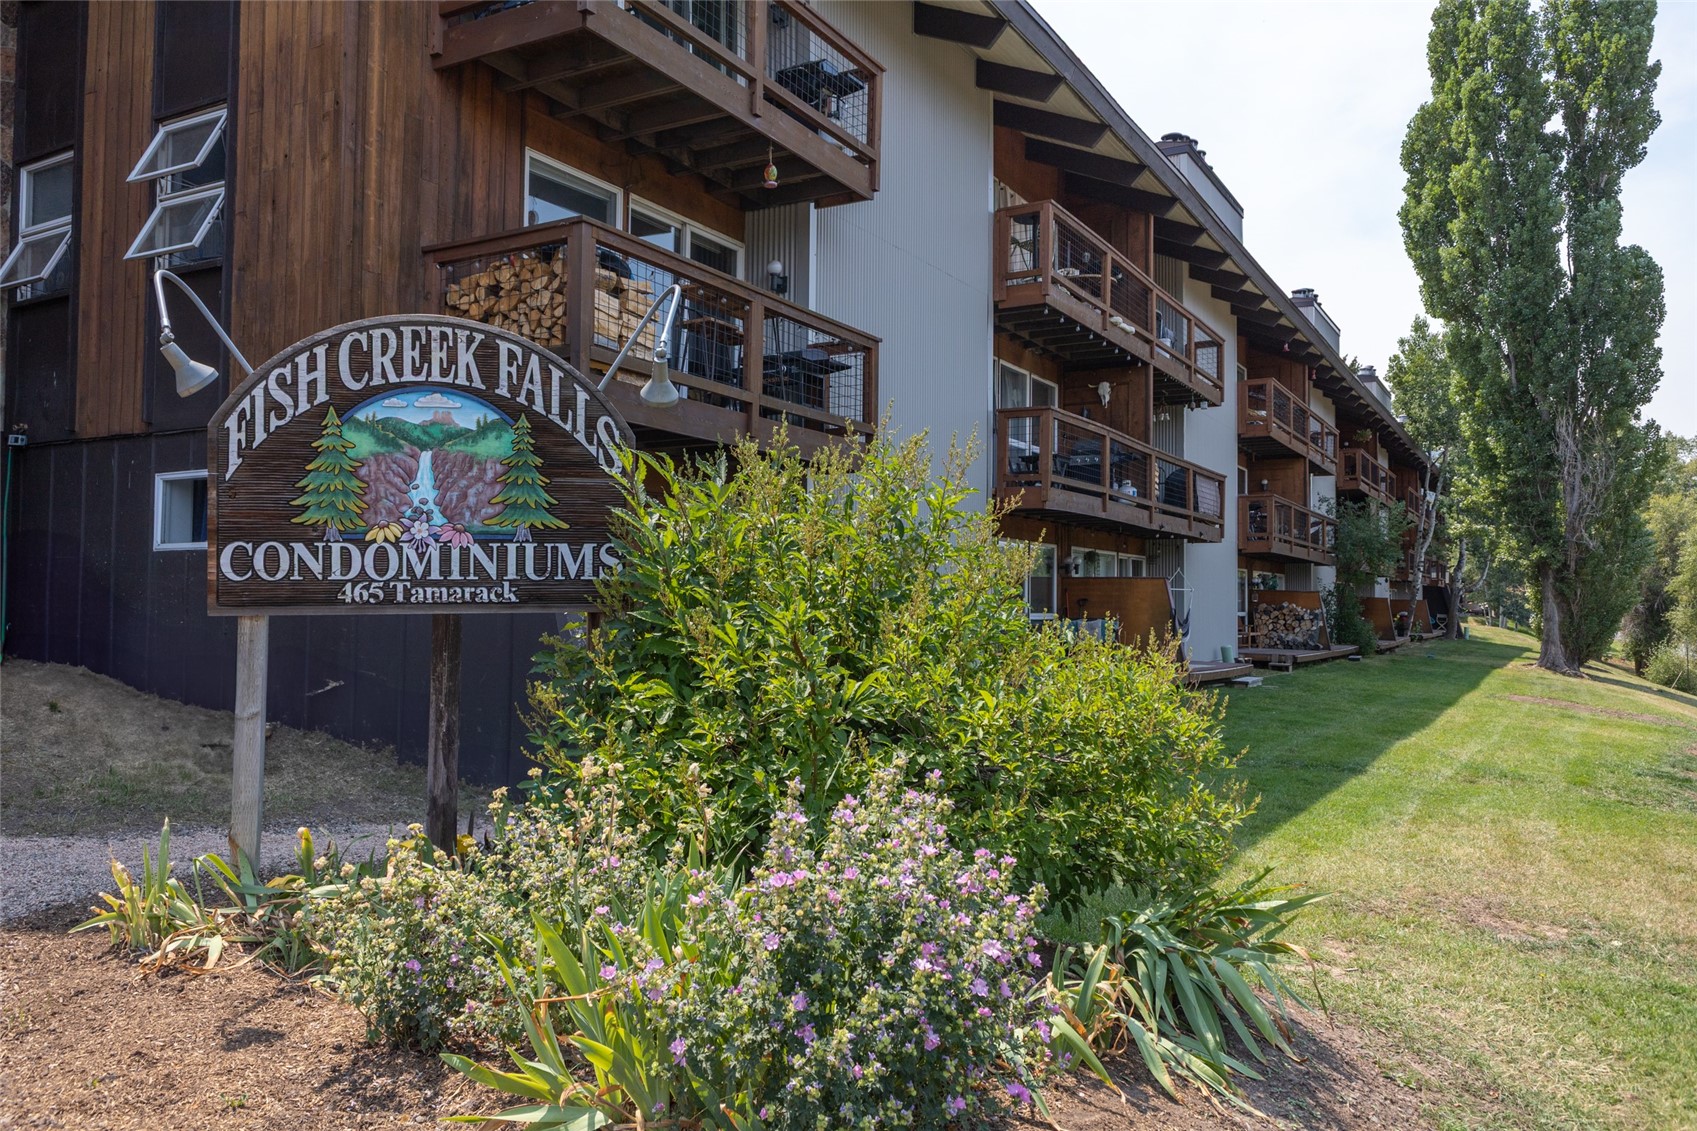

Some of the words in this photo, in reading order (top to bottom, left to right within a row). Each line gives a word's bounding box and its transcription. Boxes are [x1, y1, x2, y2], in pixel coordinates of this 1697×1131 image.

[224, 343, 331, 481] FISH
[338, 325, 486, 390] CREEK
[495, 338, 622, 475] FALLS
[219, 541, 624, 582] CONDOMINIUMS
[337, 581, 384, 603] 465
[388, 581, 519, 603] Tamarack
